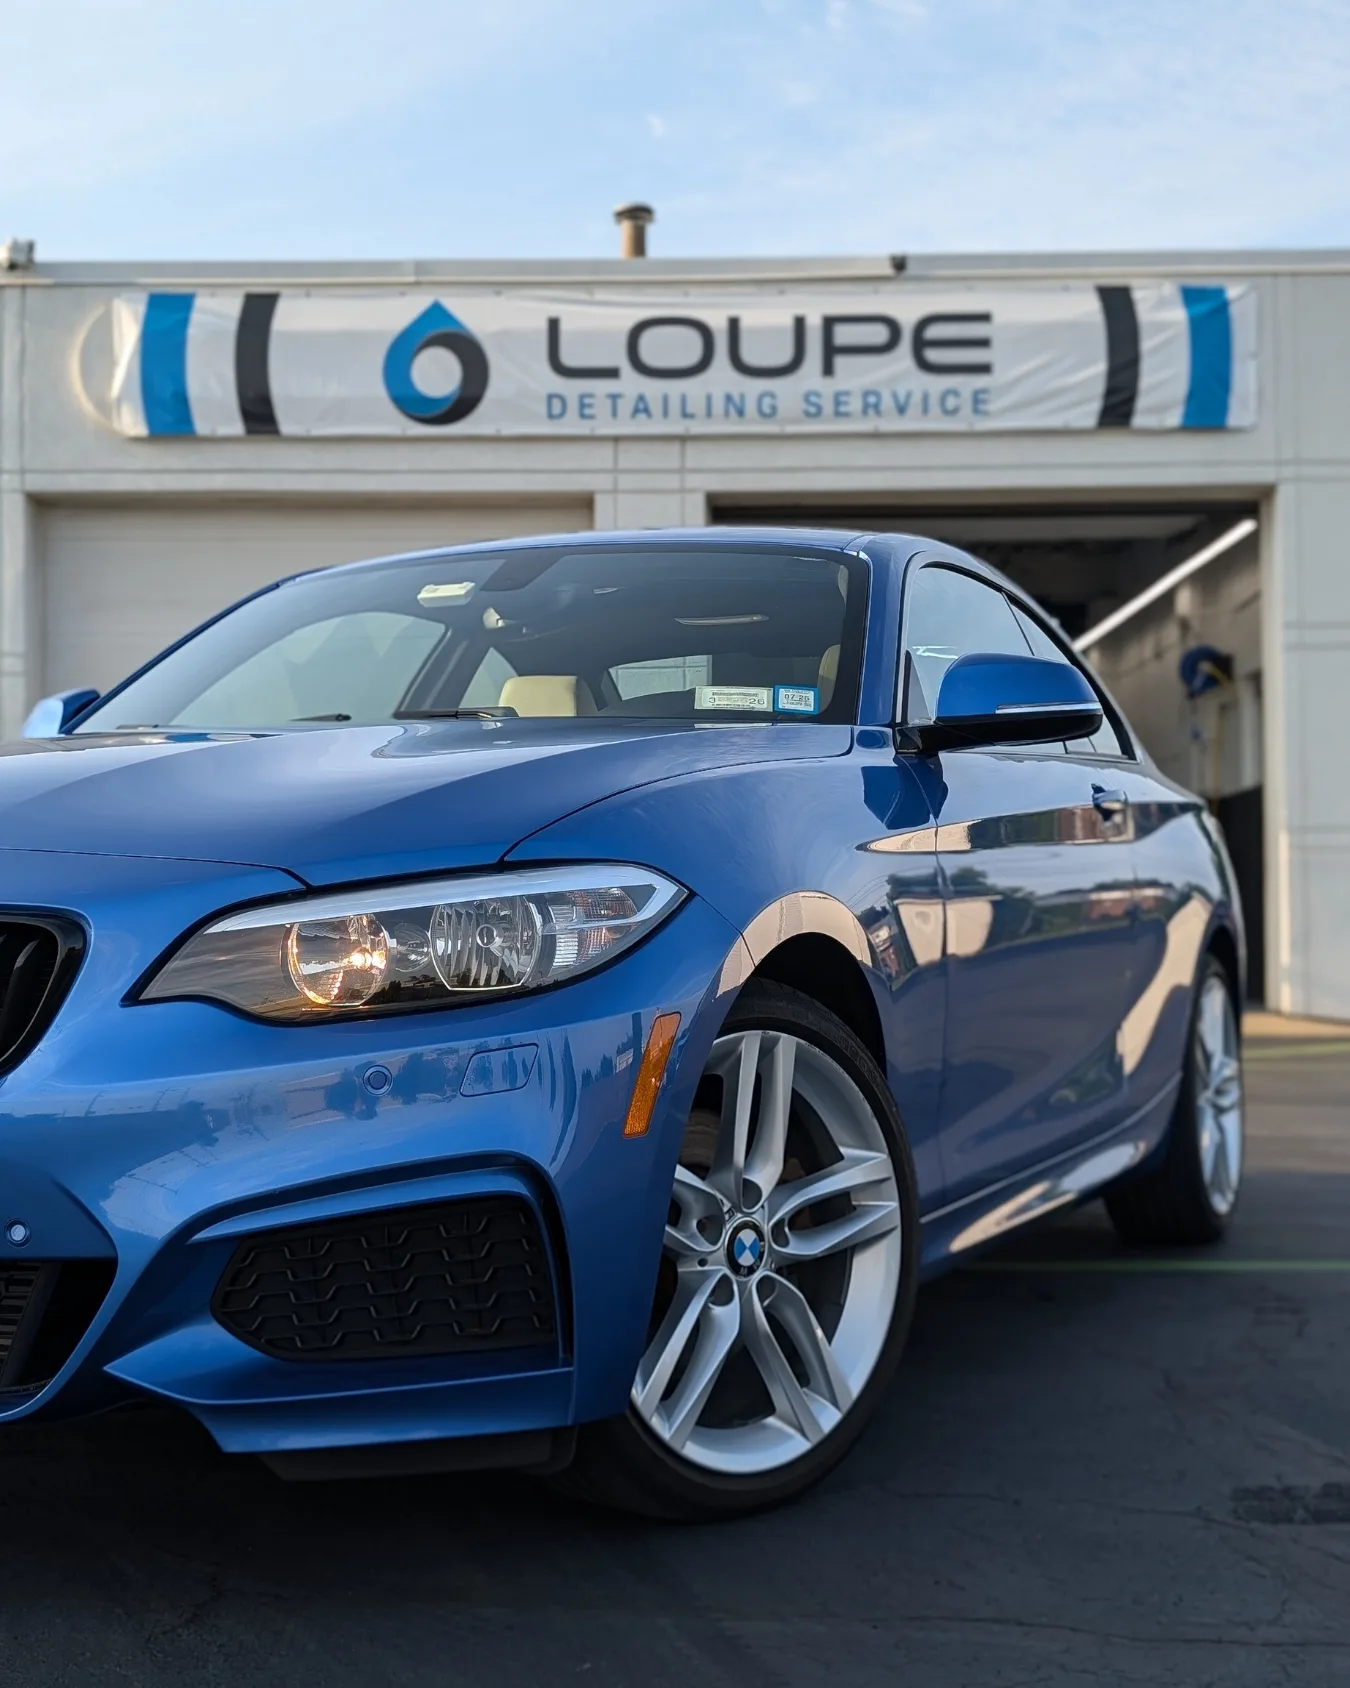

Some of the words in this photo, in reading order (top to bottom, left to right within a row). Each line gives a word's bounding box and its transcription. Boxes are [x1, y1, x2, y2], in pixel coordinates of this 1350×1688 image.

[547, 312, 993, 379] LOUPE
[546, 391, 779, 420] DETAILING
[802, 388, 991, 418] SERVICE
